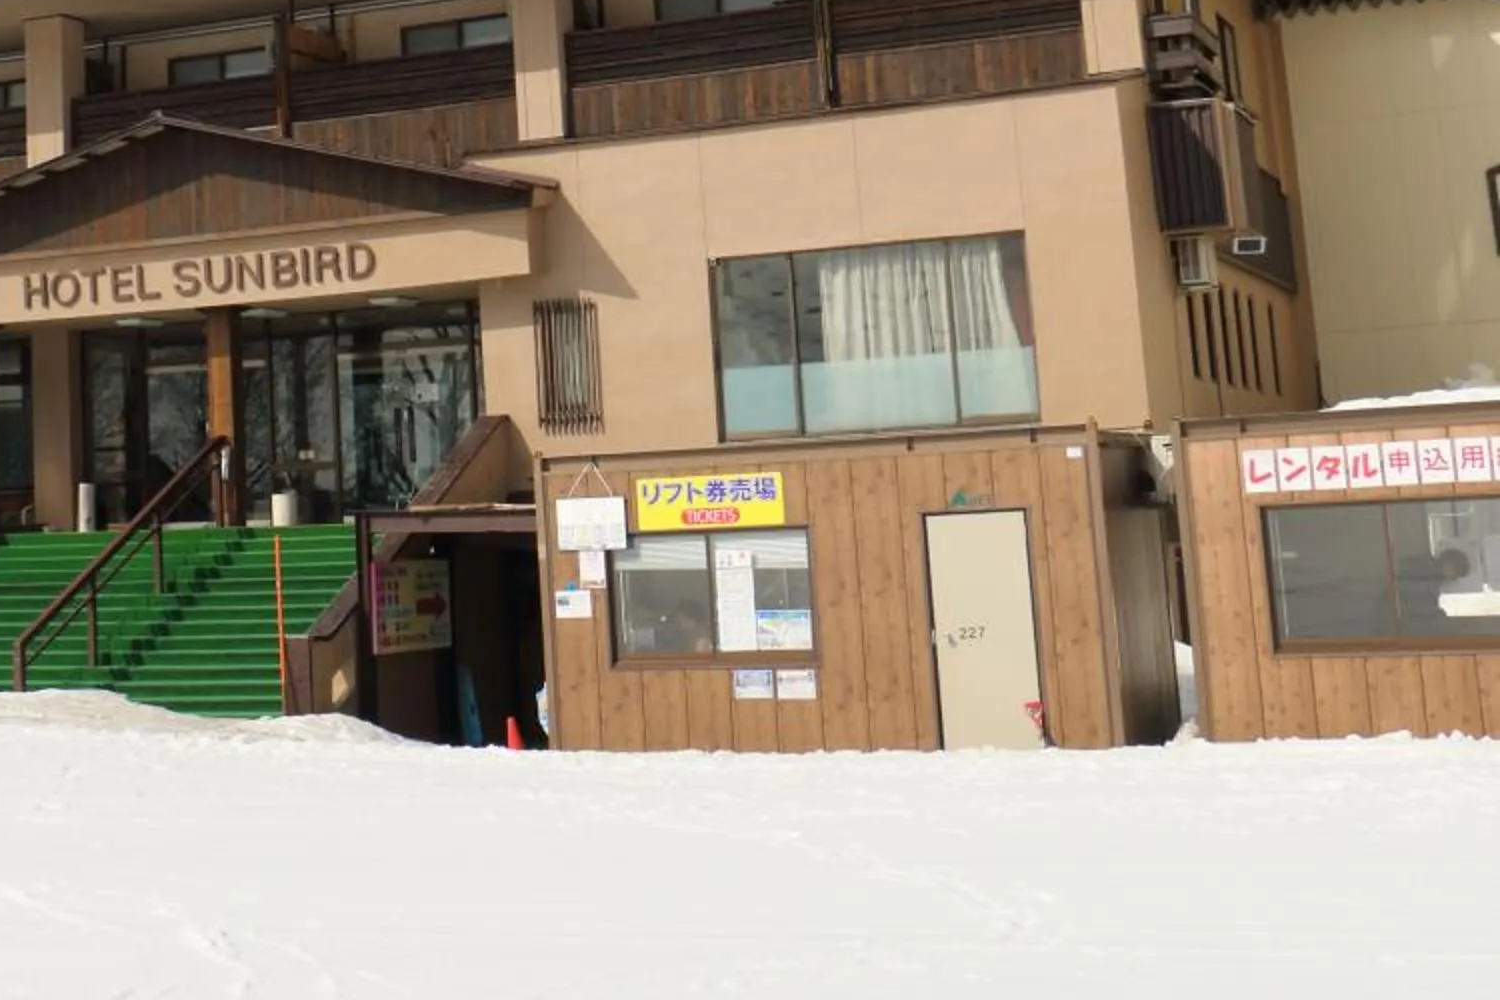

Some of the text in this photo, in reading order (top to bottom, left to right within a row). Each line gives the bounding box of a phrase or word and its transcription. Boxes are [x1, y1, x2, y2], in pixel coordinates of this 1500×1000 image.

[23, 243, 377, 311] HOTEL SUNBIRD
[1250, 444, 1500, 484] レンタル申込用
[643, 477, 776, 505] リフト券売場
